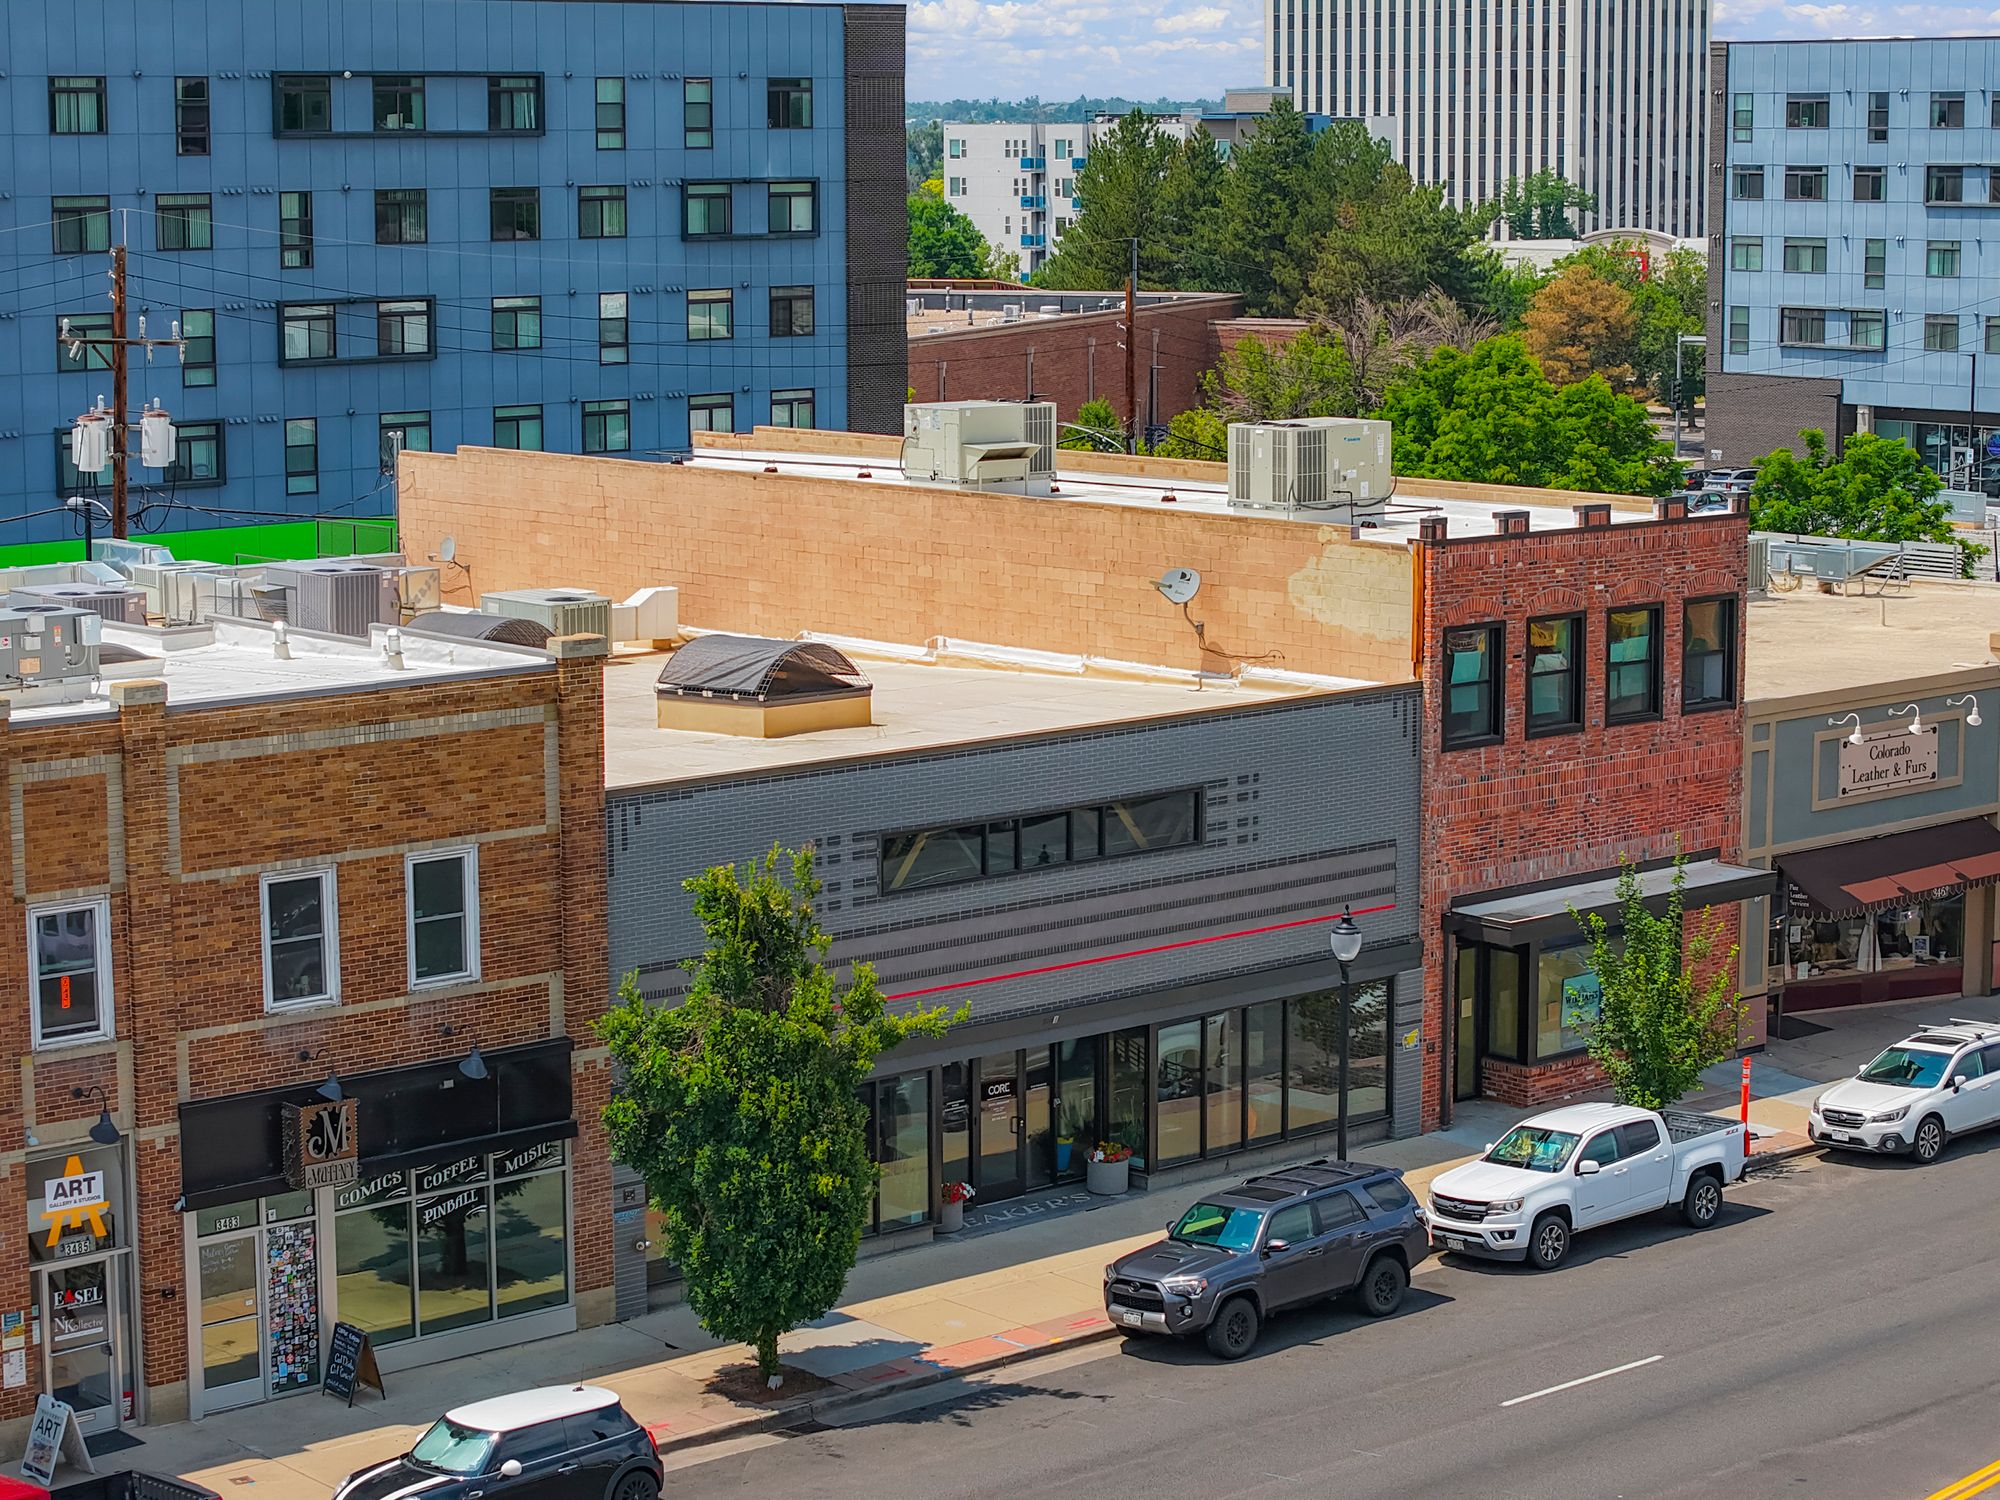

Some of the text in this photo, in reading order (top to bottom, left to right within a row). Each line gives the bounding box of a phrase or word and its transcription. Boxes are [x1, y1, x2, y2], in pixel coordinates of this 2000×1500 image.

[1870, 741, 1911, 760] Colorado
[1852, 760, 1927, 783] Leather & Furs
[504, 1141, 553, 1174] MUSIC
[307, 1161, 355, 1186] MUTINY
[423, 1155, 479, 1190] COFFEE
[53, 1175, 96, 1200] ART
[338, 1170, 403, 1208] COMICS
[49, 1200, 73, 1209] GALLERY
[79, 1194, 101, 1203] STUDIOS
[423, 1188, 479, 1225] PINBALL
[216, 1216, 239, 1231] 3483
[65, 1241, 90, 1256] 3485
[54, 1286, 103, 1306] EASEL
[35, 1415, 61, 1440] ART
